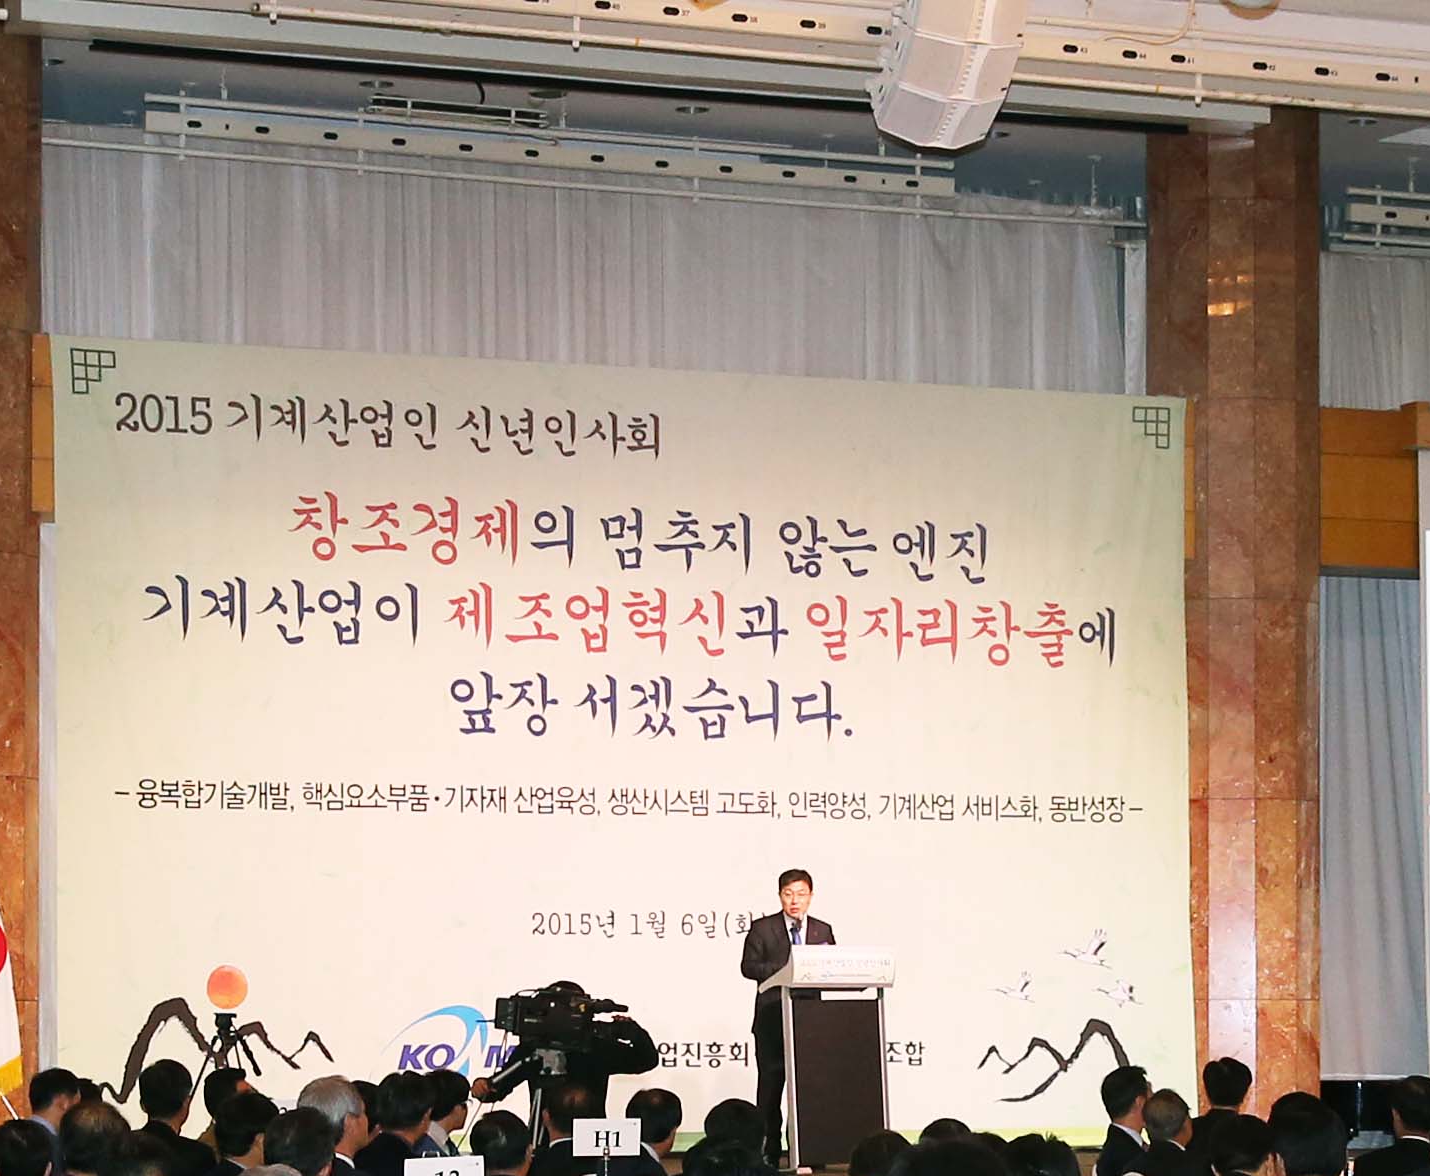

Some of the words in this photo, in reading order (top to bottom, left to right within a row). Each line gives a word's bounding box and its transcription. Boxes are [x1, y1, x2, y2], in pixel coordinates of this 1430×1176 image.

[114, 392, 213, 435] 2015
[226, 392, 437, 451] 기계산업인
[455, 404, 660, 460] 신년인사회
[288, 490, 576, 563] 창조경제의
[599, 506, 752, 574] 멈추지
[778, 515, 879, 579] 않는
[892, 520, 988, 585] 엔진
[142, 574, 419, 647] 기계산업이
[447, 581, 791, 657] 제조업혁신과
[806, 594, 1117, 669] 일자리창출에
[449, 670, 559, 738] 앞장
[574, 673, 854, 742] 서겠습니다.
[135, 778, 295, 812] 융복합기술개발,
[513, 786, 601, 816] 산업육성,
[607, 787, 709, 817] 생산시스템
[715, 790, 781, 820] 고도화,
[788, 791, 872, 820] 인력양성,
[879, 792, 955, 822] 기계산업
[961, 794, 1043, 823] 서비스화,
[531, 909, 615, 939] 2015년
[630, 910, 666, 939] 1월
[681, 910, 765, 939] 6일(화
[593, 1130, 622, 1148] H1
